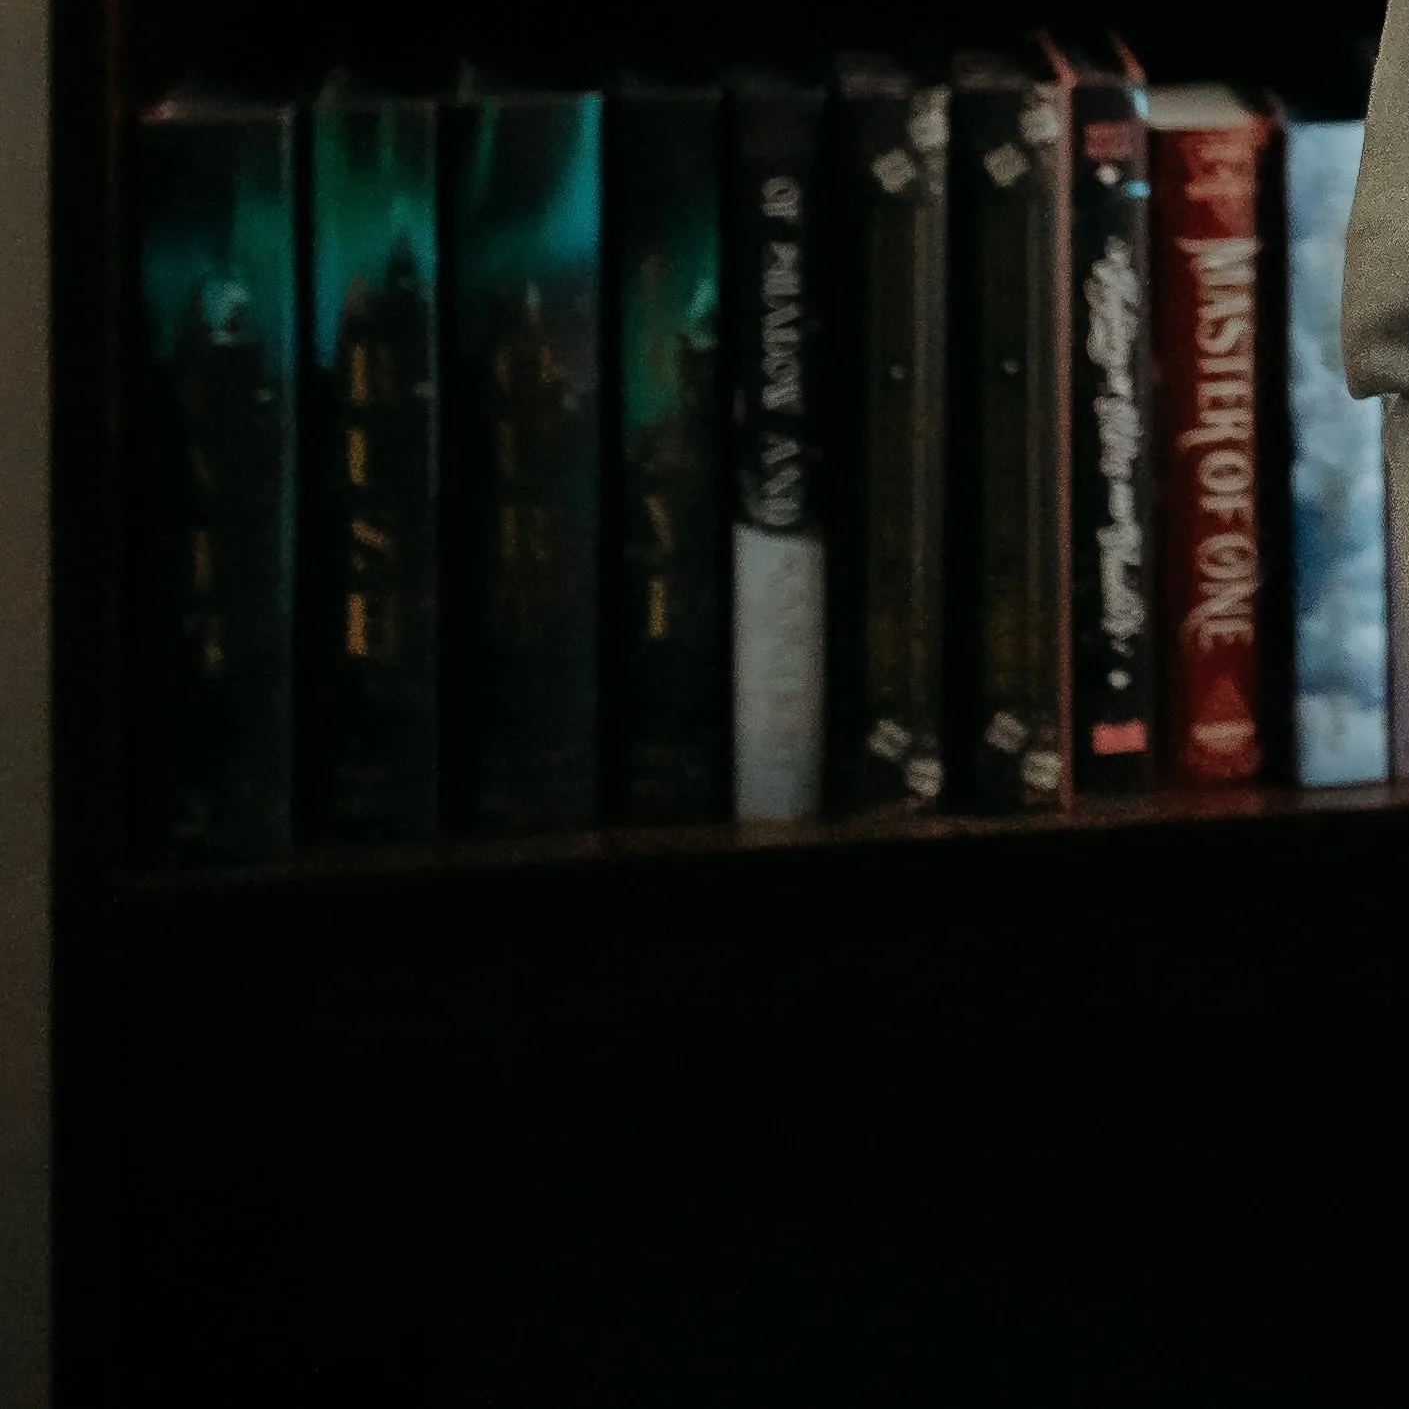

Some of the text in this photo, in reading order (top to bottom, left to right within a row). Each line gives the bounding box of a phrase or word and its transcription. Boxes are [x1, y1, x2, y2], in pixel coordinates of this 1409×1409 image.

[1175, 236, 1260, 452] MASTER
[1197, 450, 1252, 524] OF
[1177, 530, 1259, 653] ONE
